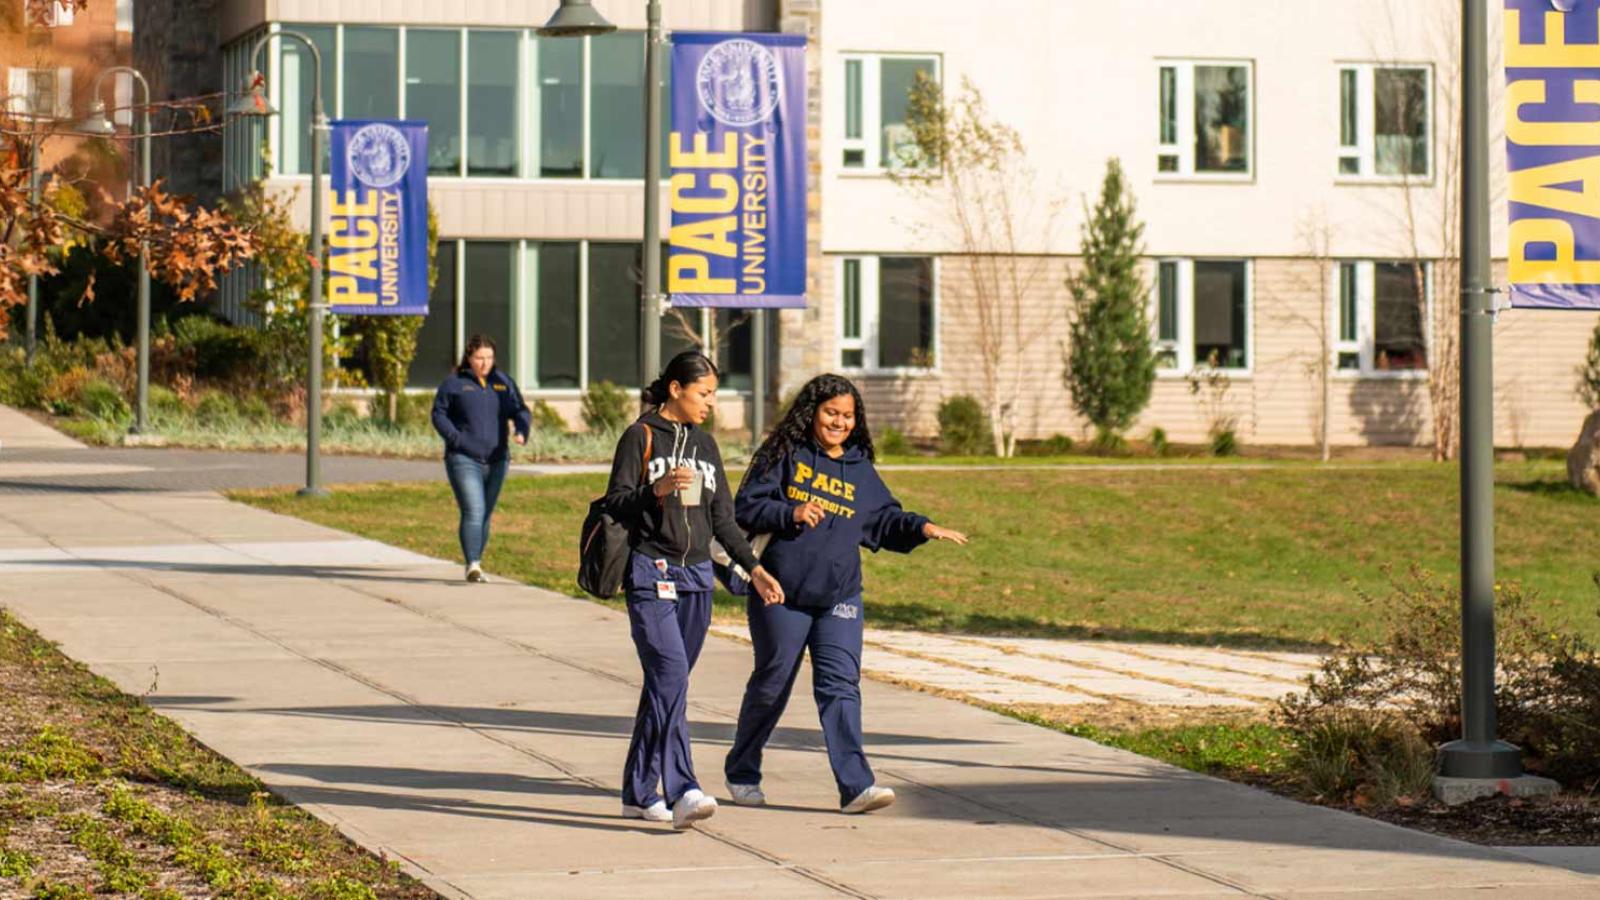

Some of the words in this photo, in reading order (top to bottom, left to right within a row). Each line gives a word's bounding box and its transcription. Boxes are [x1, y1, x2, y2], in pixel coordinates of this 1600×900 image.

[669, 132, 738, 294] PACE
[743, 133, 767, 294] UNIVERSITY
[1504, 9, 1600, 285] PACE
[328, 189, 378, 305] PACE
[382, 190, 400, 306] UNIVERSITY
[794, 462, 855, 501] PACE
